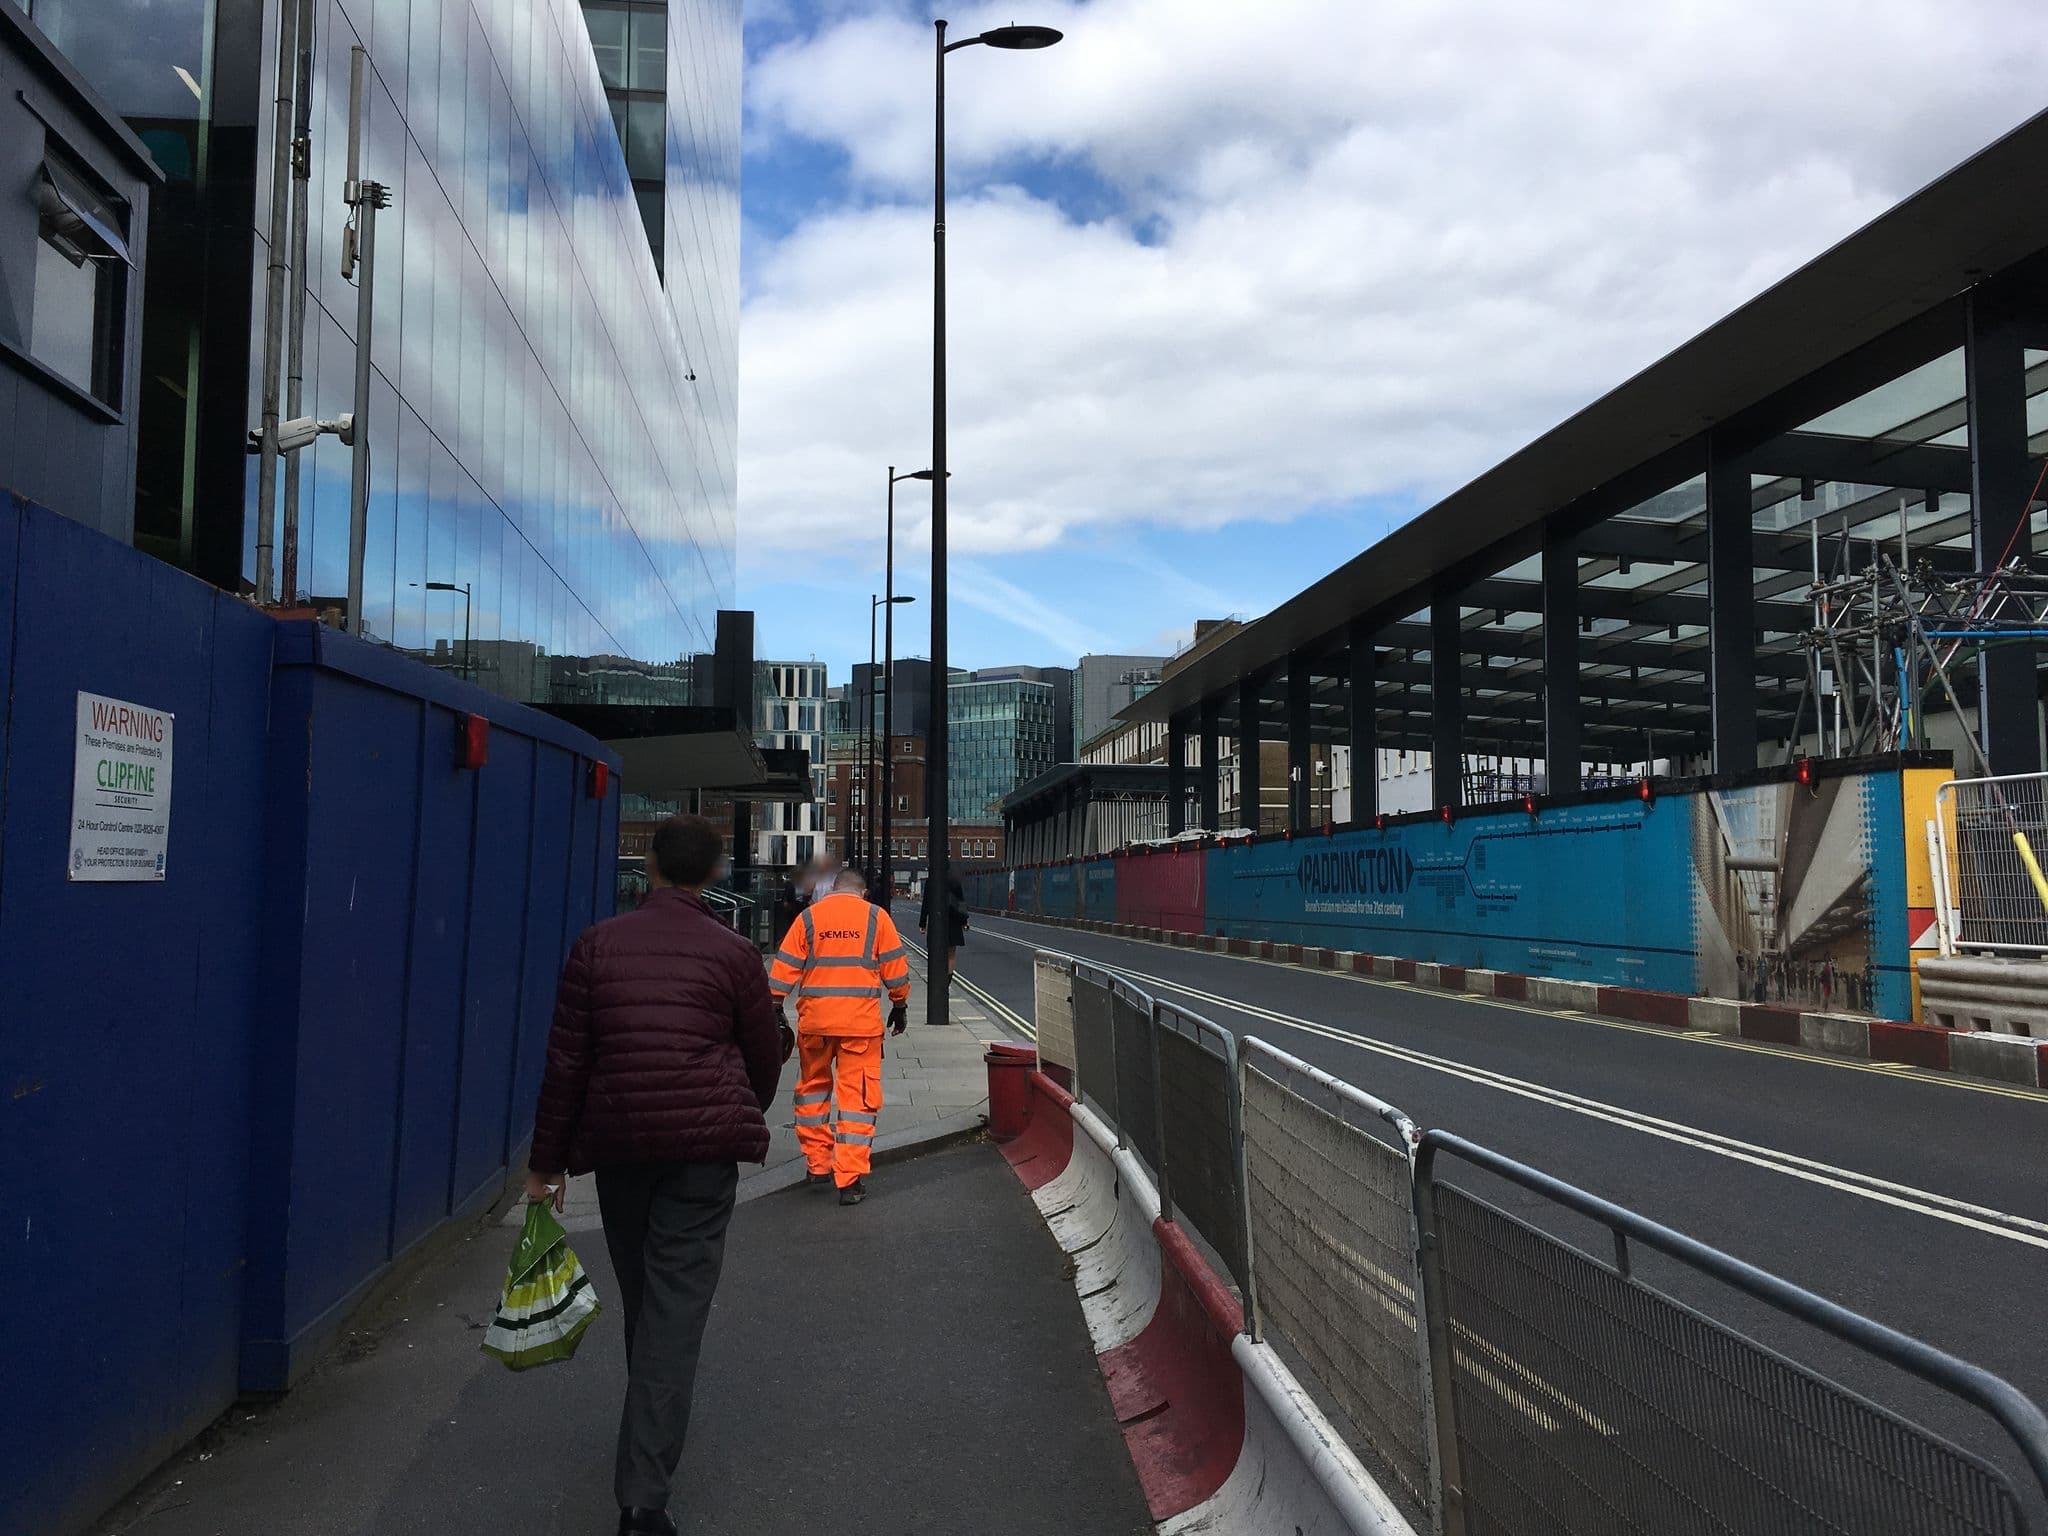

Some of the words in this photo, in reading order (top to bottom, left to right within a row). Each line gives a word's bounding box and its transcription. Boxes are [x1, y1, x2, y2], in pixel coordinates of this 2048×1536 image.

[92, 701, 163, 743] WARNING
[84, 734, 101, 748] These
[102, 738, 127, 752] Premises
[127, 744, 135, 753] are
[156, 748, 163, 761] By
[97, 759, 155, 793] CLIPFINE
[114, 795, 138, 805] SECURITY
[77, 819, 85, 830] 24
[86, 820, 99, 831] Hour
[99, 821, 118, 832] Control
[118, 822, 133, 833] Centre
[97, 846, 109, 856] HEAD
[1304, 847, 1403, 895] PADDINGTON
[819, 930, 861, 941] SIEMENS
